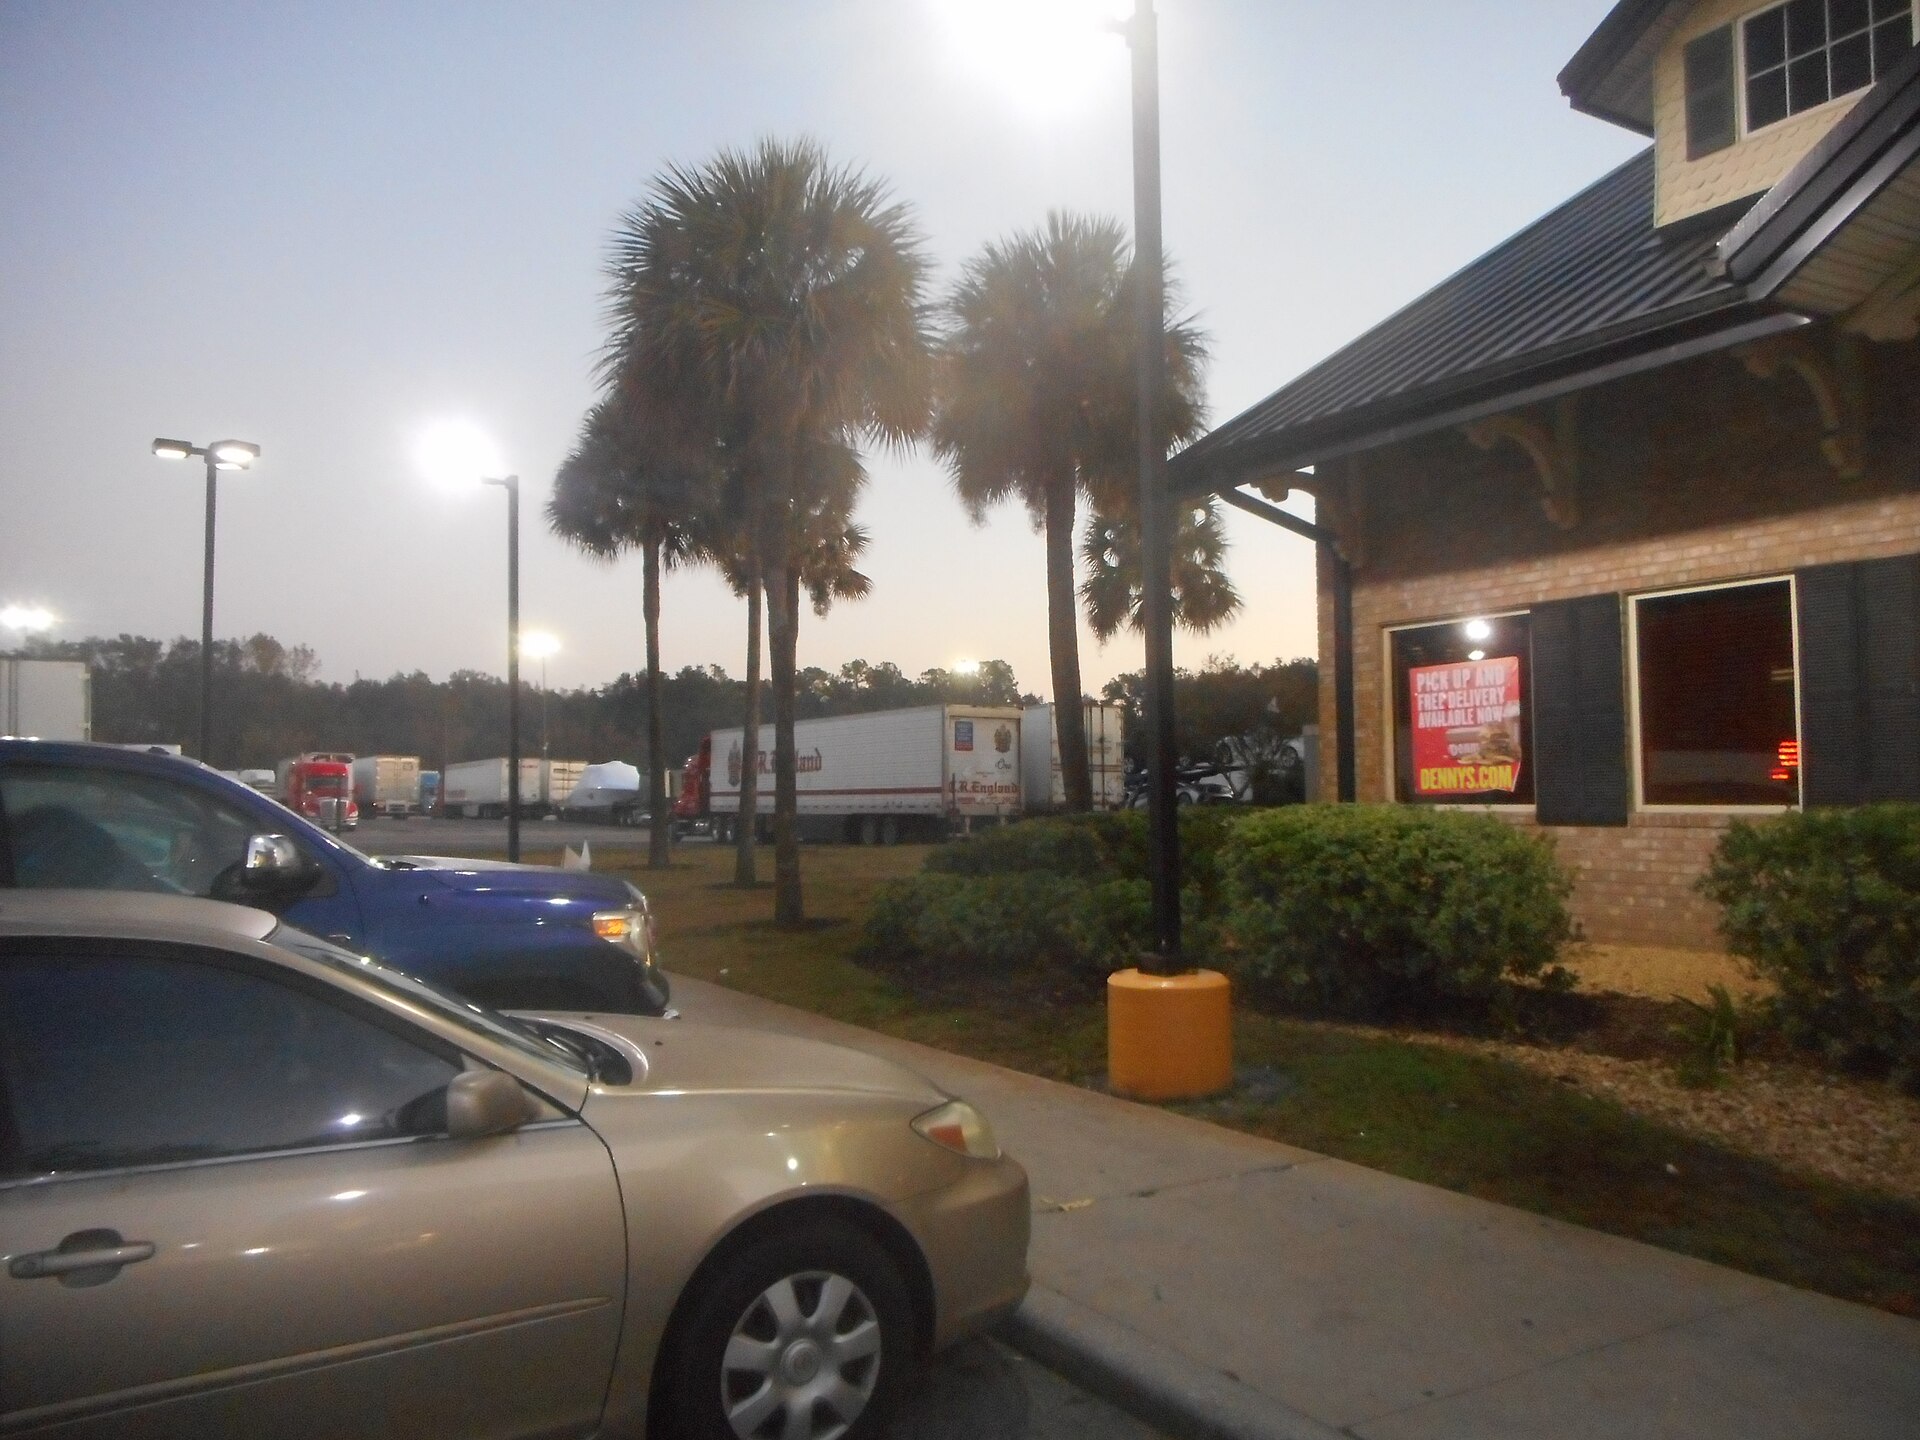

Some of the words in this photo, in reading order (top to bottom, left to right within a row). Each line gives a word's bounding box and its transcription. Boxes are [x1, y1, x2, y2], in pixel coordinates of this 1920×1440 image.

[1416, 671, 1448, 692] PICK
[1452, 668, 1471, 688] UP
[1475, 665, 1505, 687] AND
[1417, 692, 1447, 711] FREE
[1448, 687, 1505, 709] DELIVERY
[1418, 709, 1474, 729] AVAILABLE
[1477, 706, 1503, 725] NOW
[1420, 765, 1513, 790] DENNYS.COM
